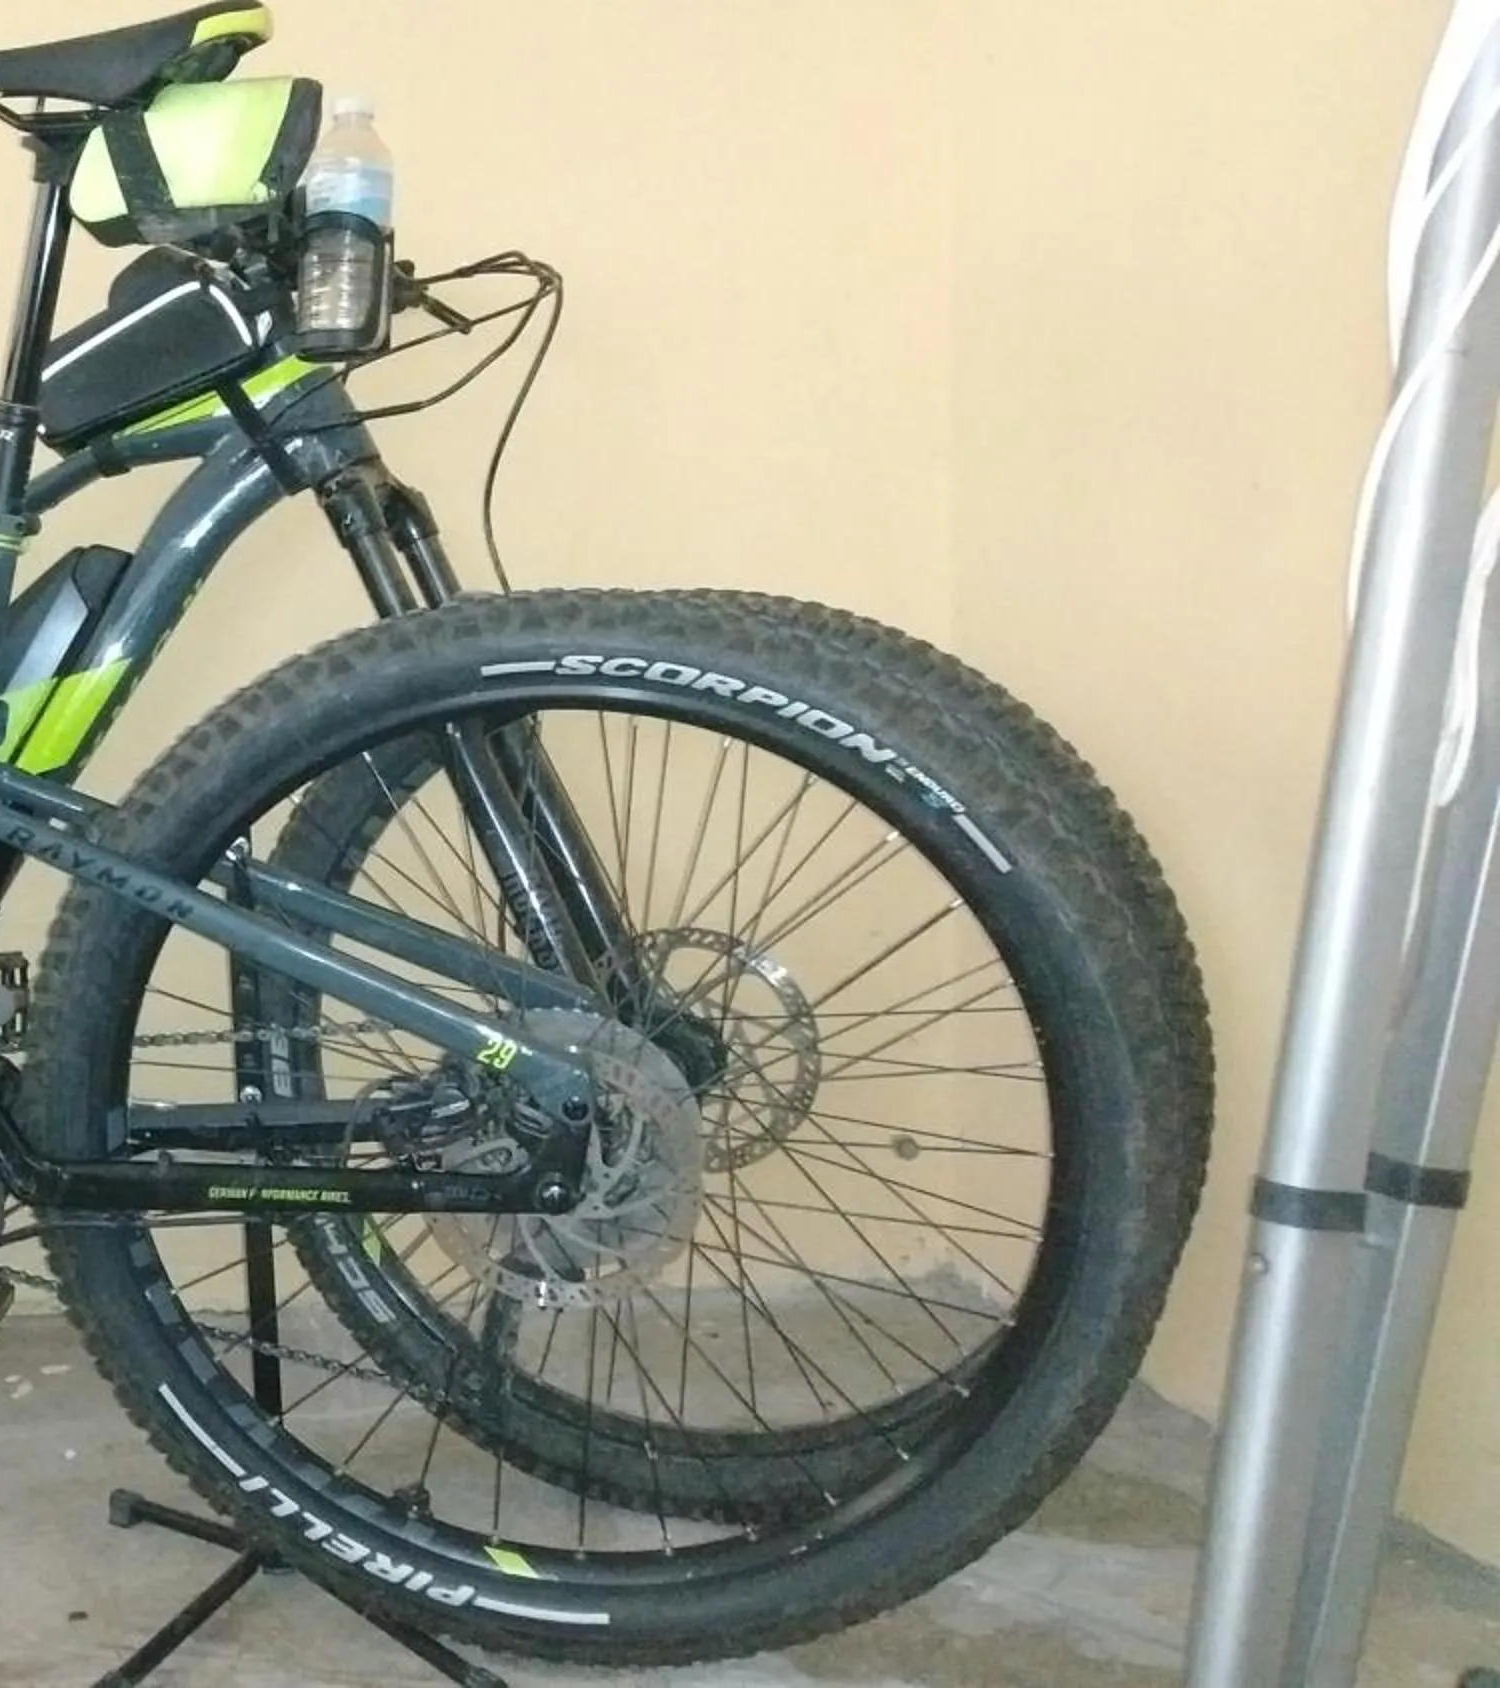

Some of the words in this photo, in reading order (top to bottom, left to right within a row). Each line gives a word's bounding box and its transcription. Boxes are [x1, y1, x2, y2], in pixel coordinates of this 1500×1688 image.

[554, 654, 898, 764] SCORPION
[7, 825, 195, 919] RAYMON
[239, 1475, 477, 1607] PIRELLI
